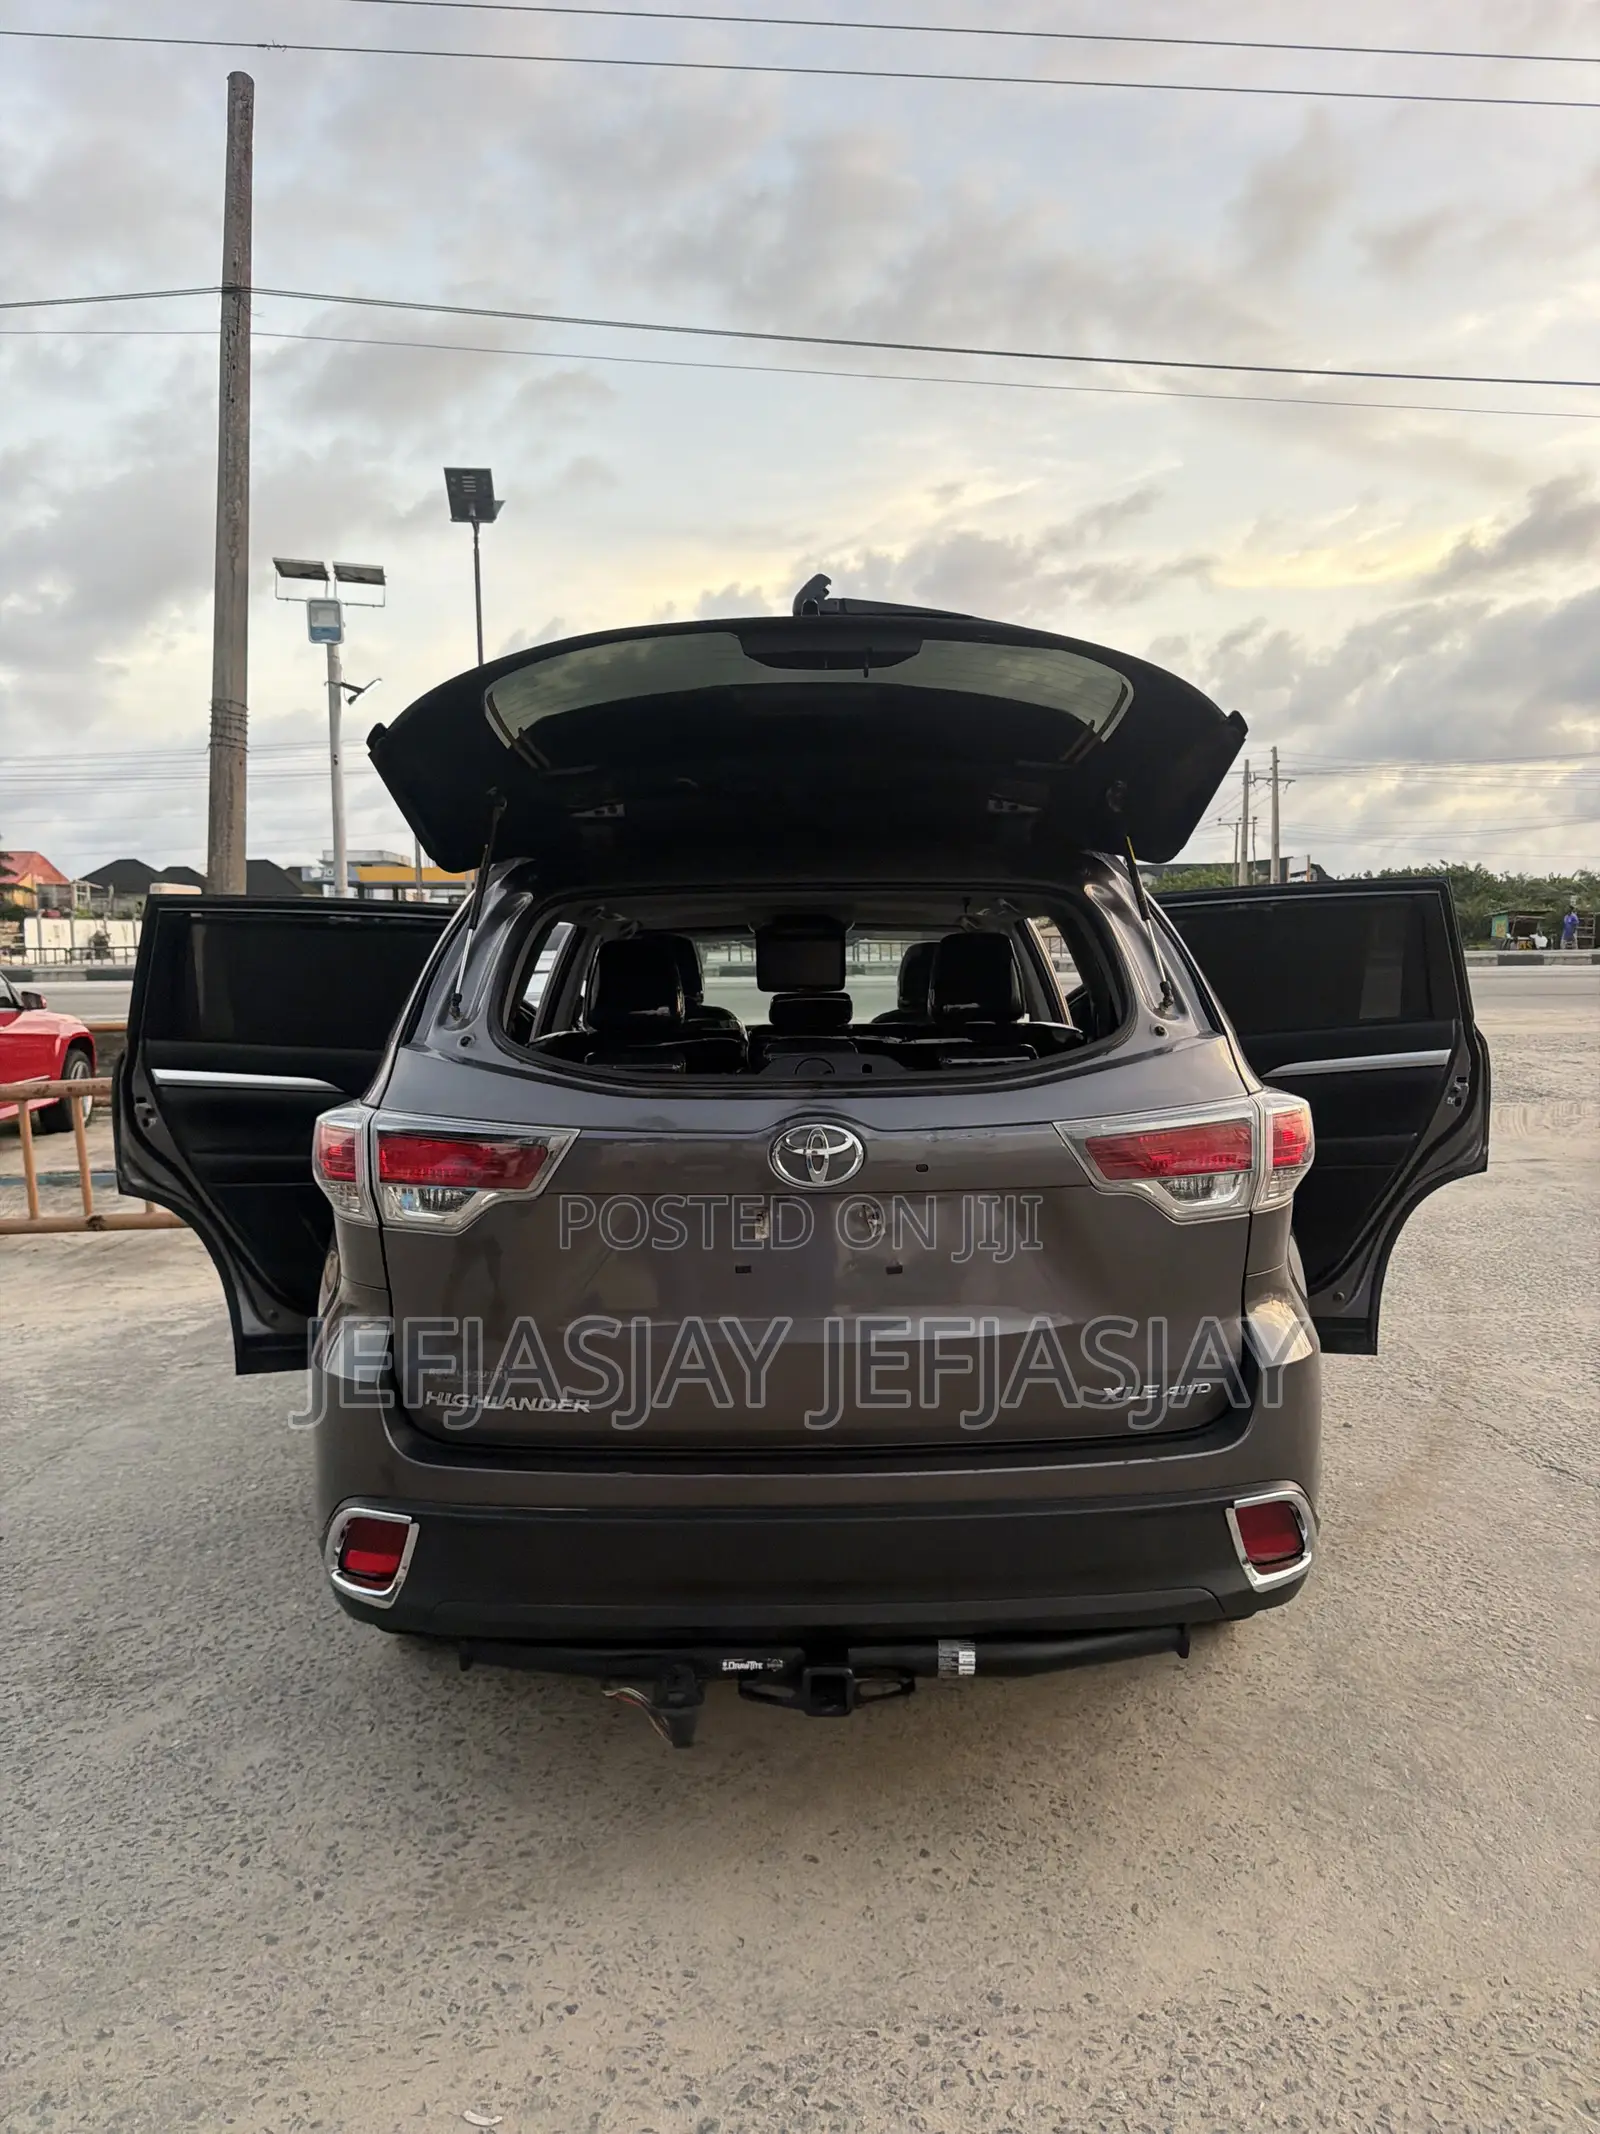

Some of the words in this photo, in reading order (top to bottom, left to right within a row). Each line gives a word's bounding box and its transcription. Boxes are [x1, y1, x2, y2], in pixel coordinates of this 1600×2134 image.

[425, 1390, 591, 1414] HIGHLANDER
[1100, 1384, 1160, 1402] XLE
[1162, 1383, 1211, 1398] AWD
